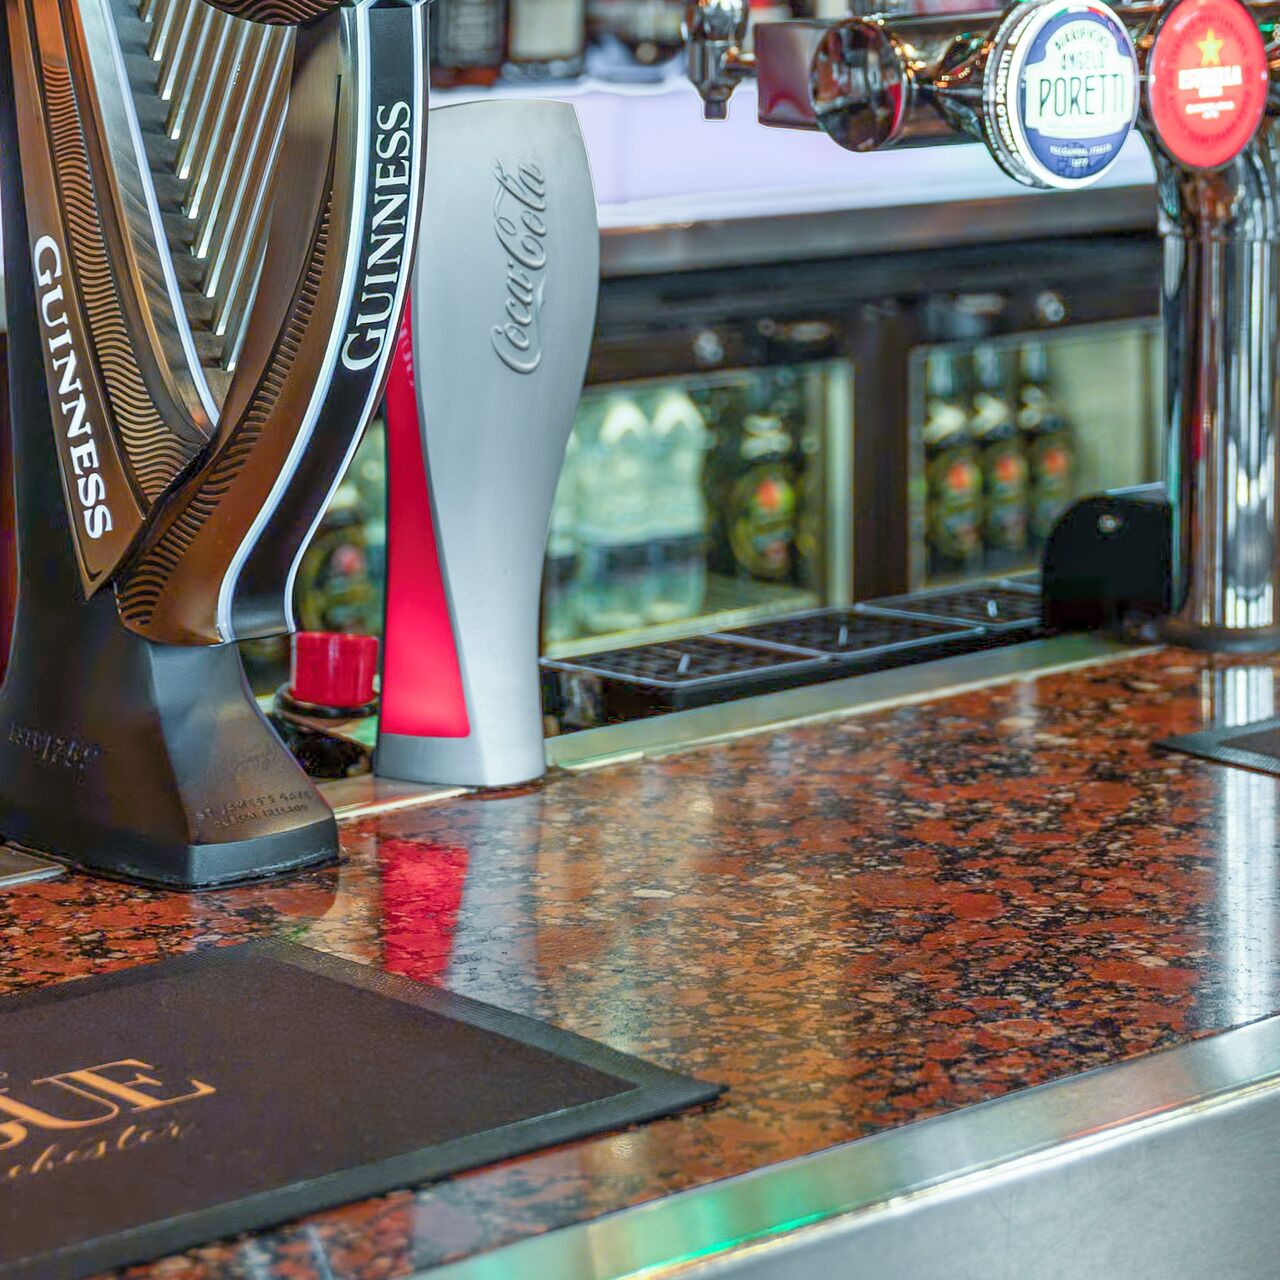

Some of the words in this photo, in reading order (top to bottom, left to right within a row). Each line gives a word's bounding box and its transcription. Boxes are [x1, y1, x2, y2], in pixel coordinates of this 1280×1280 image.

[1039, 73, 1125, 118] PORETTI
[341, 101, 411, 371] GUINNESS
[34, 234, 113, 540] GUINNESS
